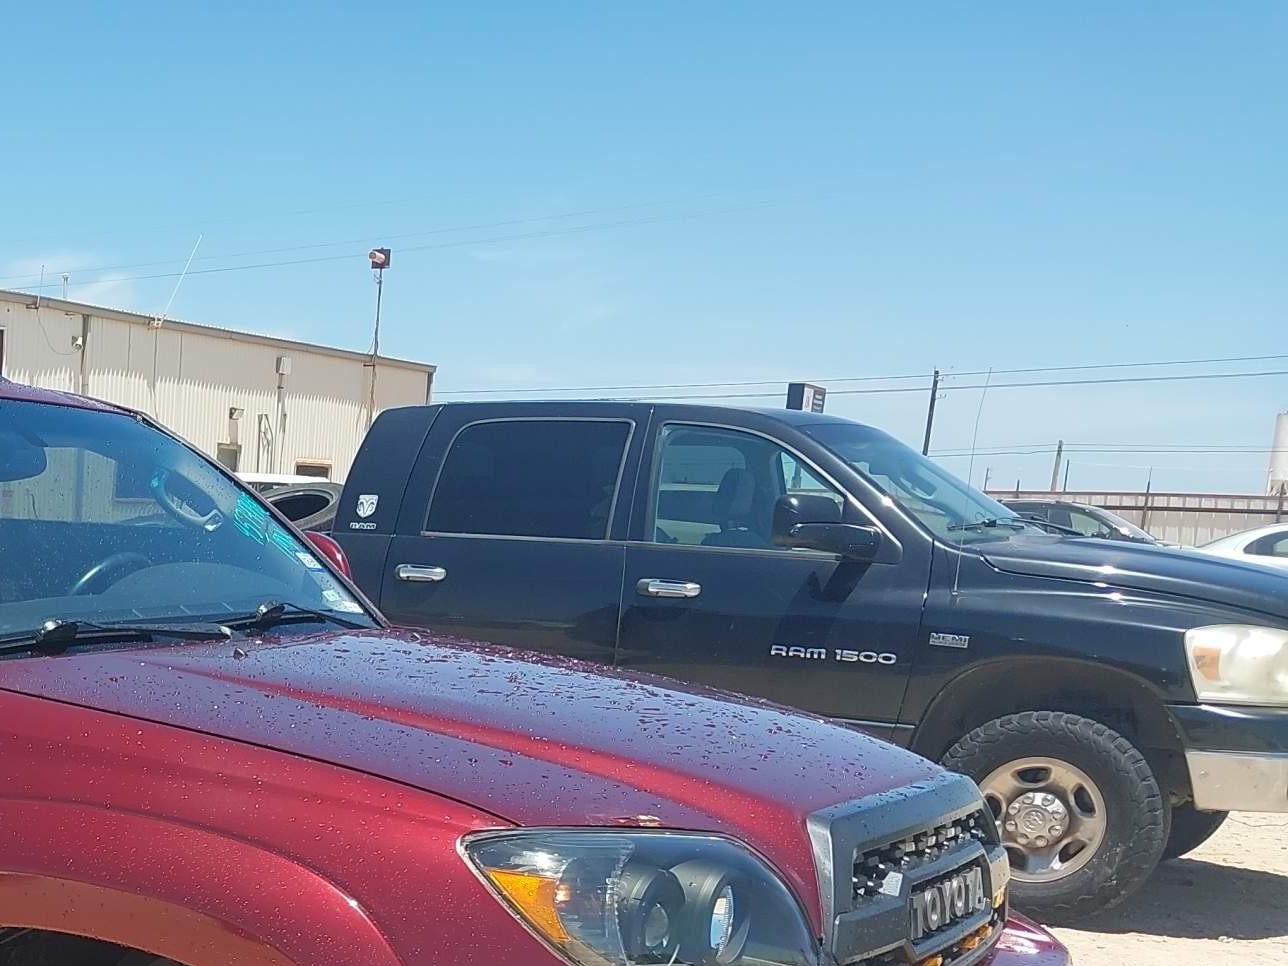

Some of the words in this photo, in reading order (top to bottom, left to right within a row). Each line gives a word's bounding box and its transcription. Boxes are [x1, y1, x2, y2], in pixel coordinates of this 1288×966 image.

[770, 644, 826, 660] RAM
[835, 648, 897, 665] 1500
[911, 866, 986, 939] TOYOTA
